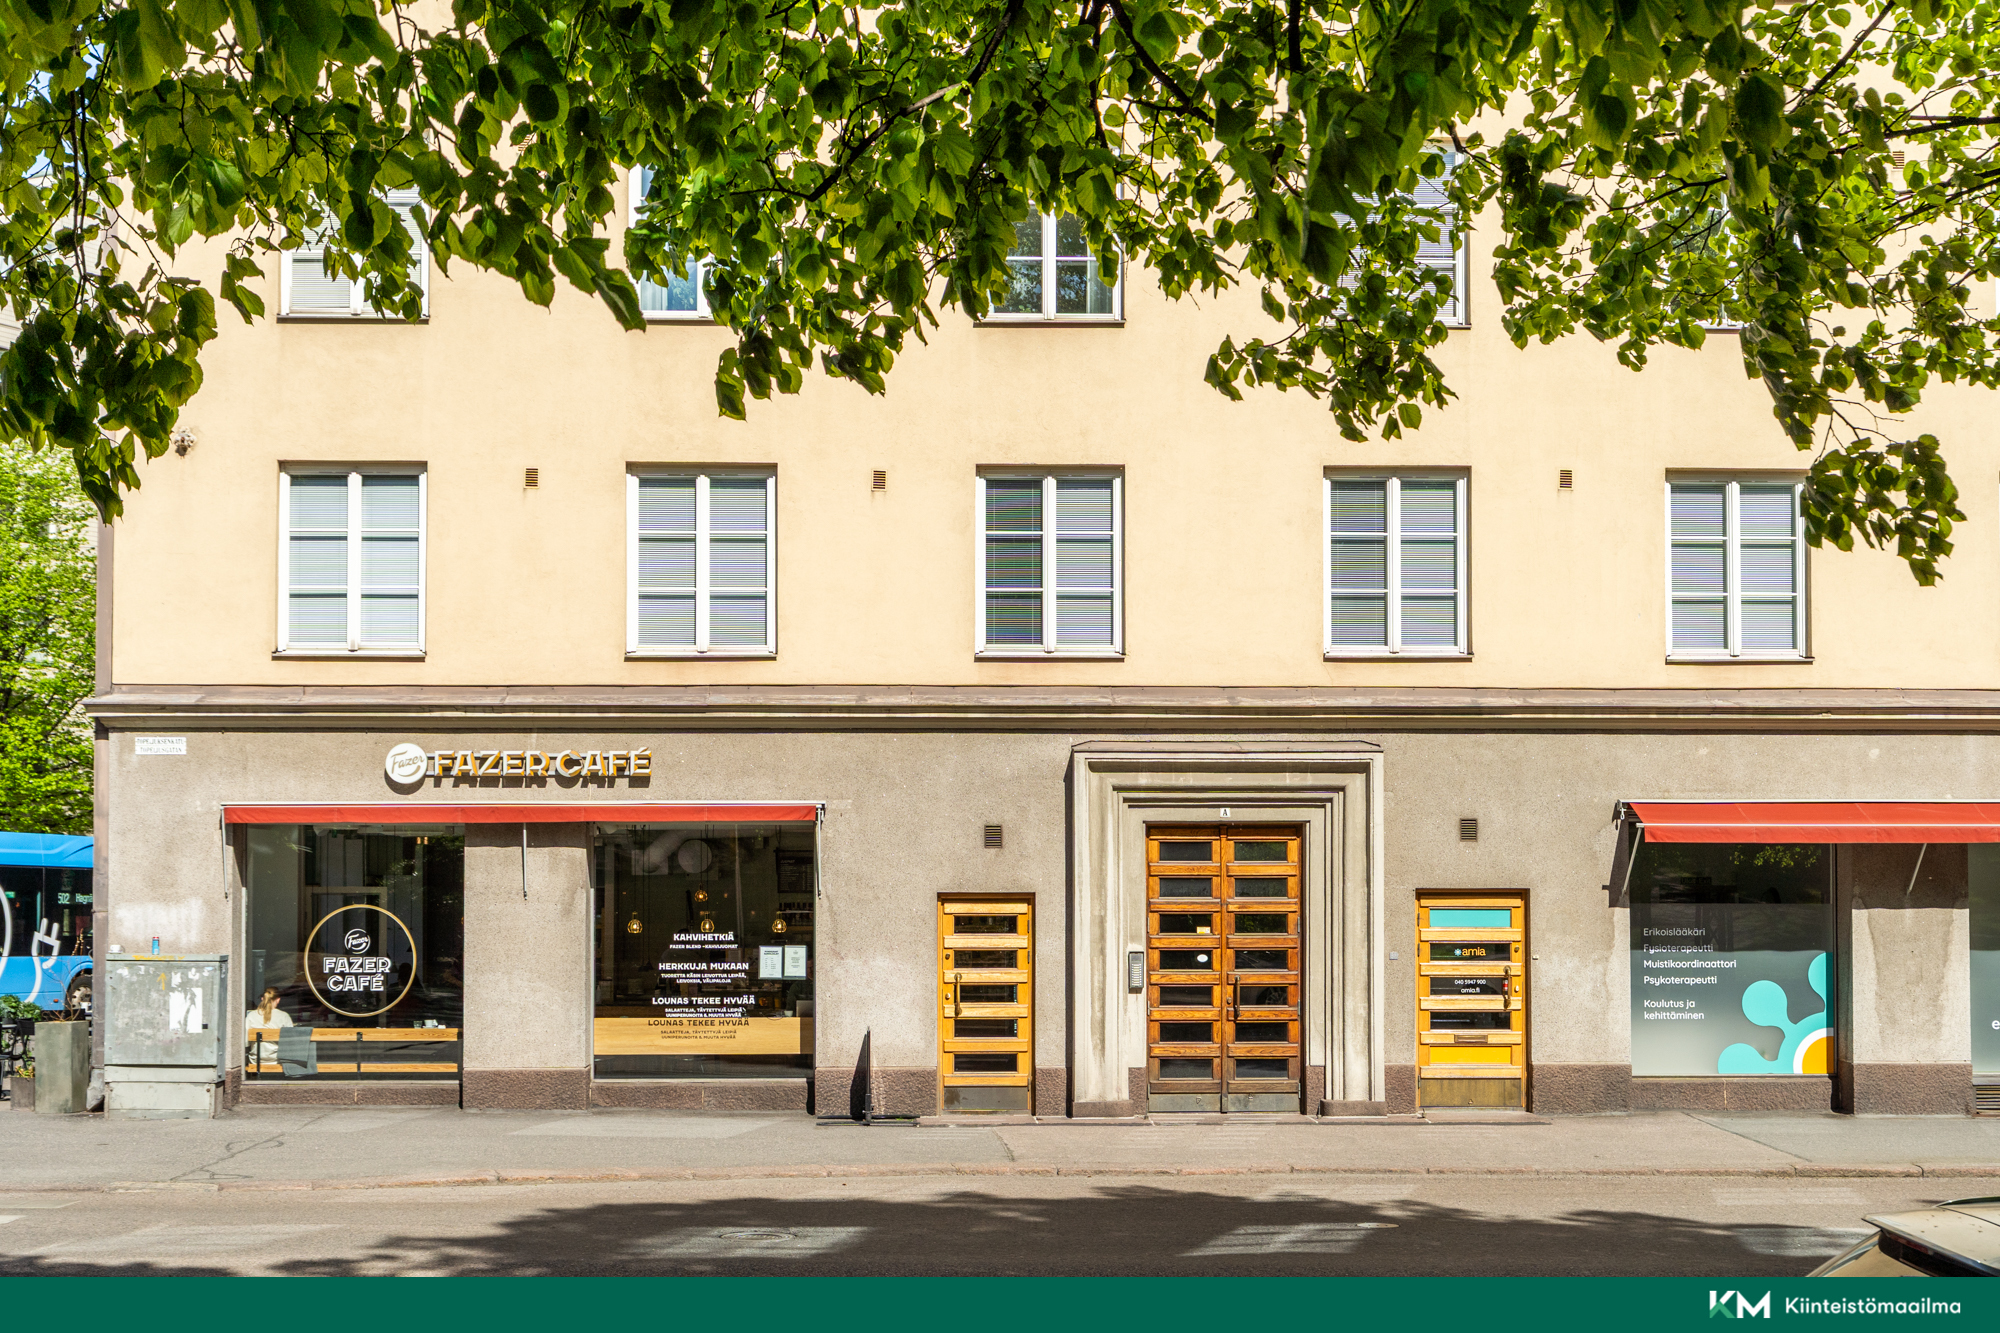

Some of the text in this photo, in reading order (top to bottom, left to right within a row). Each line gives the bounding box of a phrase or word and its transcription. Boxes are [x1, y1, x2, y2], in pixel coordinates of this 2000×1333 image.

[391, 752, 425, 774] Fazer
[434, 746, 652, 777] FAZER CAFÉ
[57, 892, 70, 904] 502
[673, 931, 734, 941] KAHVIHETKIÄ
[1643, 928, 1706, 936] Erikoislääkäri
[1462, 947, 1486, 956] amia
[1643, 944, 1714, 954] Fysioterapeutti
[323, 956, 391, 973] FAZER
[1643, 960, 1737, 968] Muistikoordinaattori
[327, 973, 384, 991] CAFÉ
[1643, 976, 1718, 986] Psykoterapeutti
[652, 994, 755, 1005] LOUNAS TEKEE HYVÄÄ
[1644, 999, 1695, 1009] Koulutus ja
[1644, 1011, 1705, 1020] kehittäminen
[718, 1018, 750, 1026] HYVÄÄ
